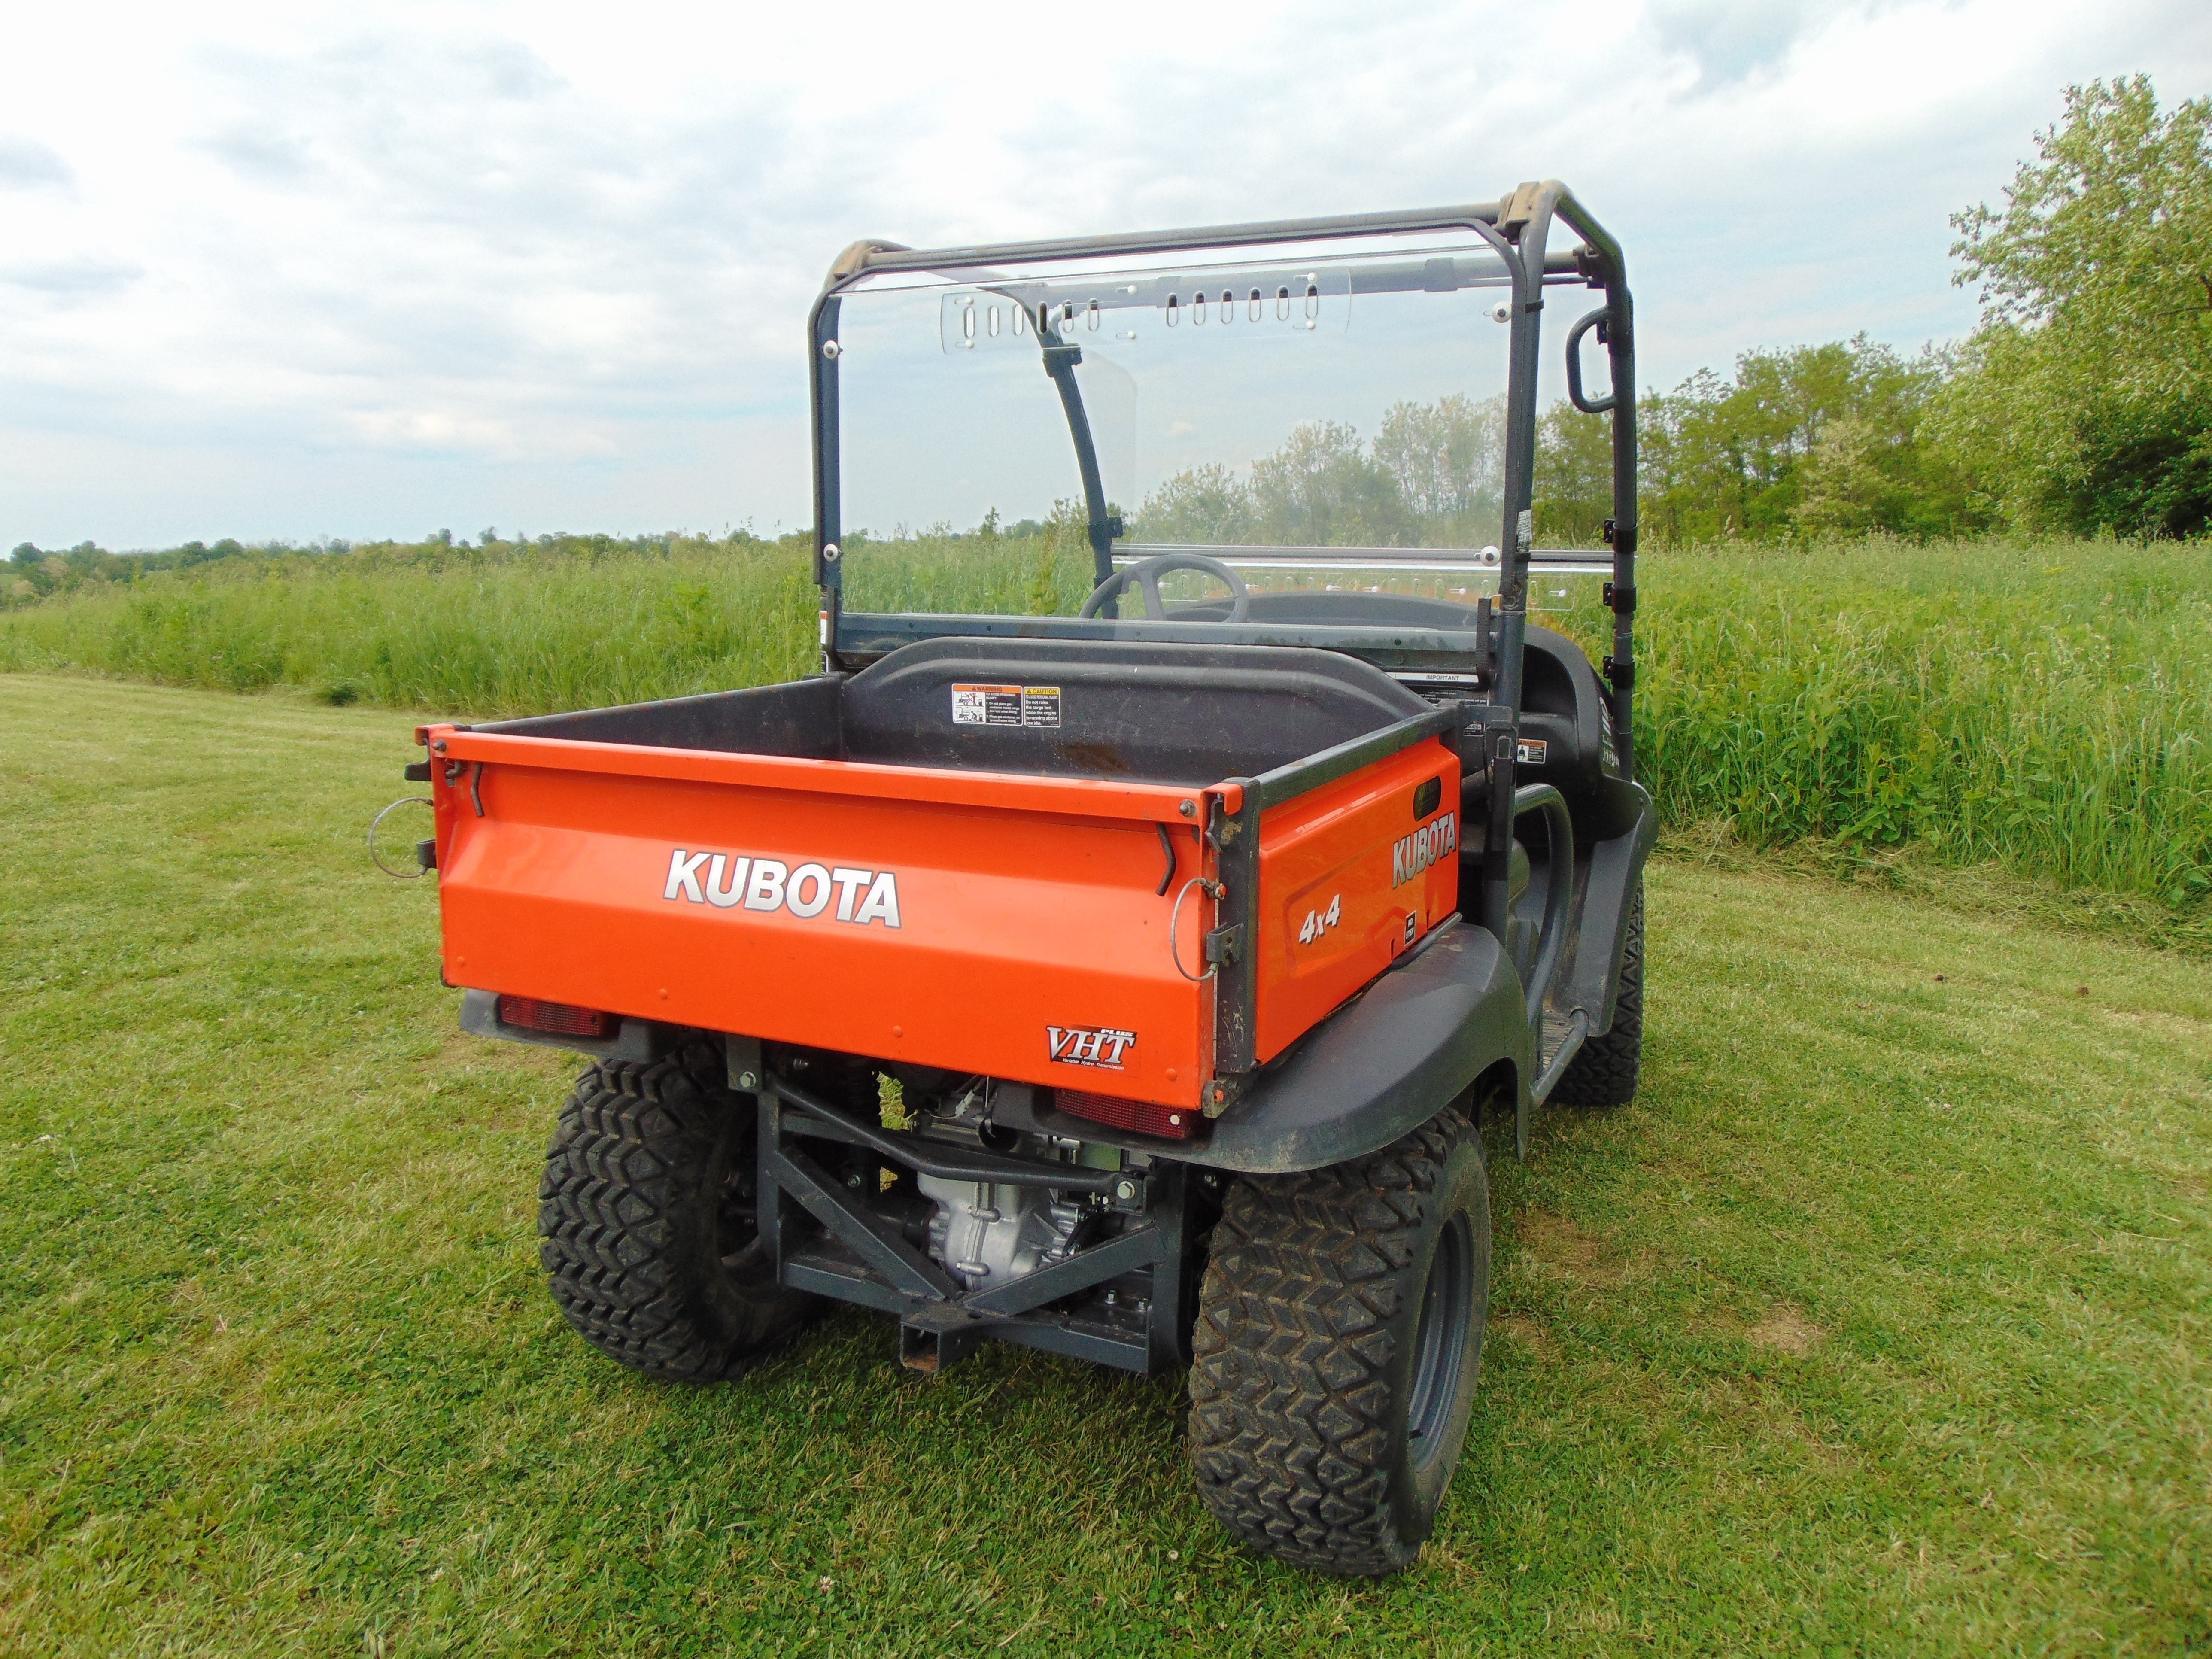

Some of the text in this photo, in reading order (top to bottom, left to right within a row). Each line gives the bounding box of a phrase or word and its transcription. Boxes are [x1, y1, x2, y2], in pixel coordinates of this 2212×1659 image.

[1392, 811, 1456, 889] KUBOTA
[663, 848, 901, 928] KUBOTA
[1299, 893, 1340, 944] 4x4
[1046, 1026, 1136, 1063] VHT
[1100, 1029, 1133, 1037] PLUS
